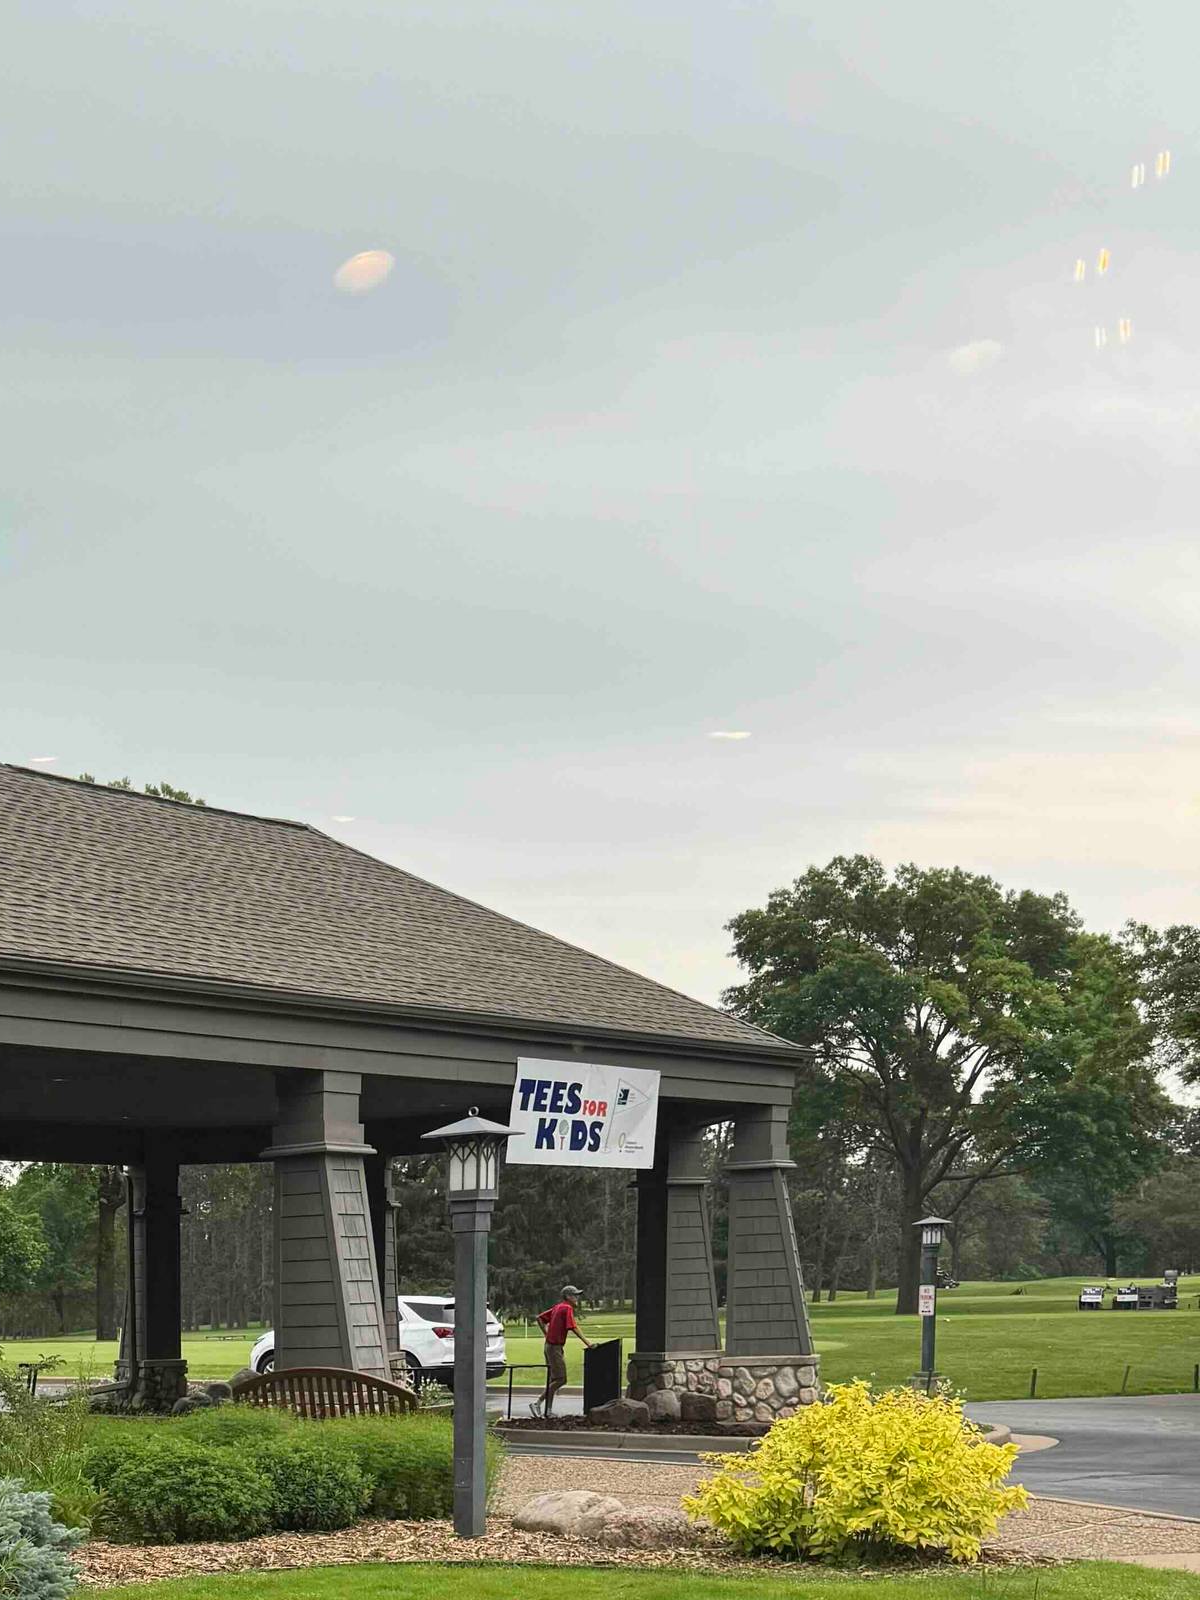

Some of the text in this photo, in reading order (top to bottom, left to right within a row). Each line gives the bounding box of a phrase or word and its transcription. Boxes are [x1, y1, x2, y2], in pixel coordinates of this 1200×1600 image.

[519, 1079, 607, 1117] TEES FOR
[535, 1118, 604, 1152] KIDS
